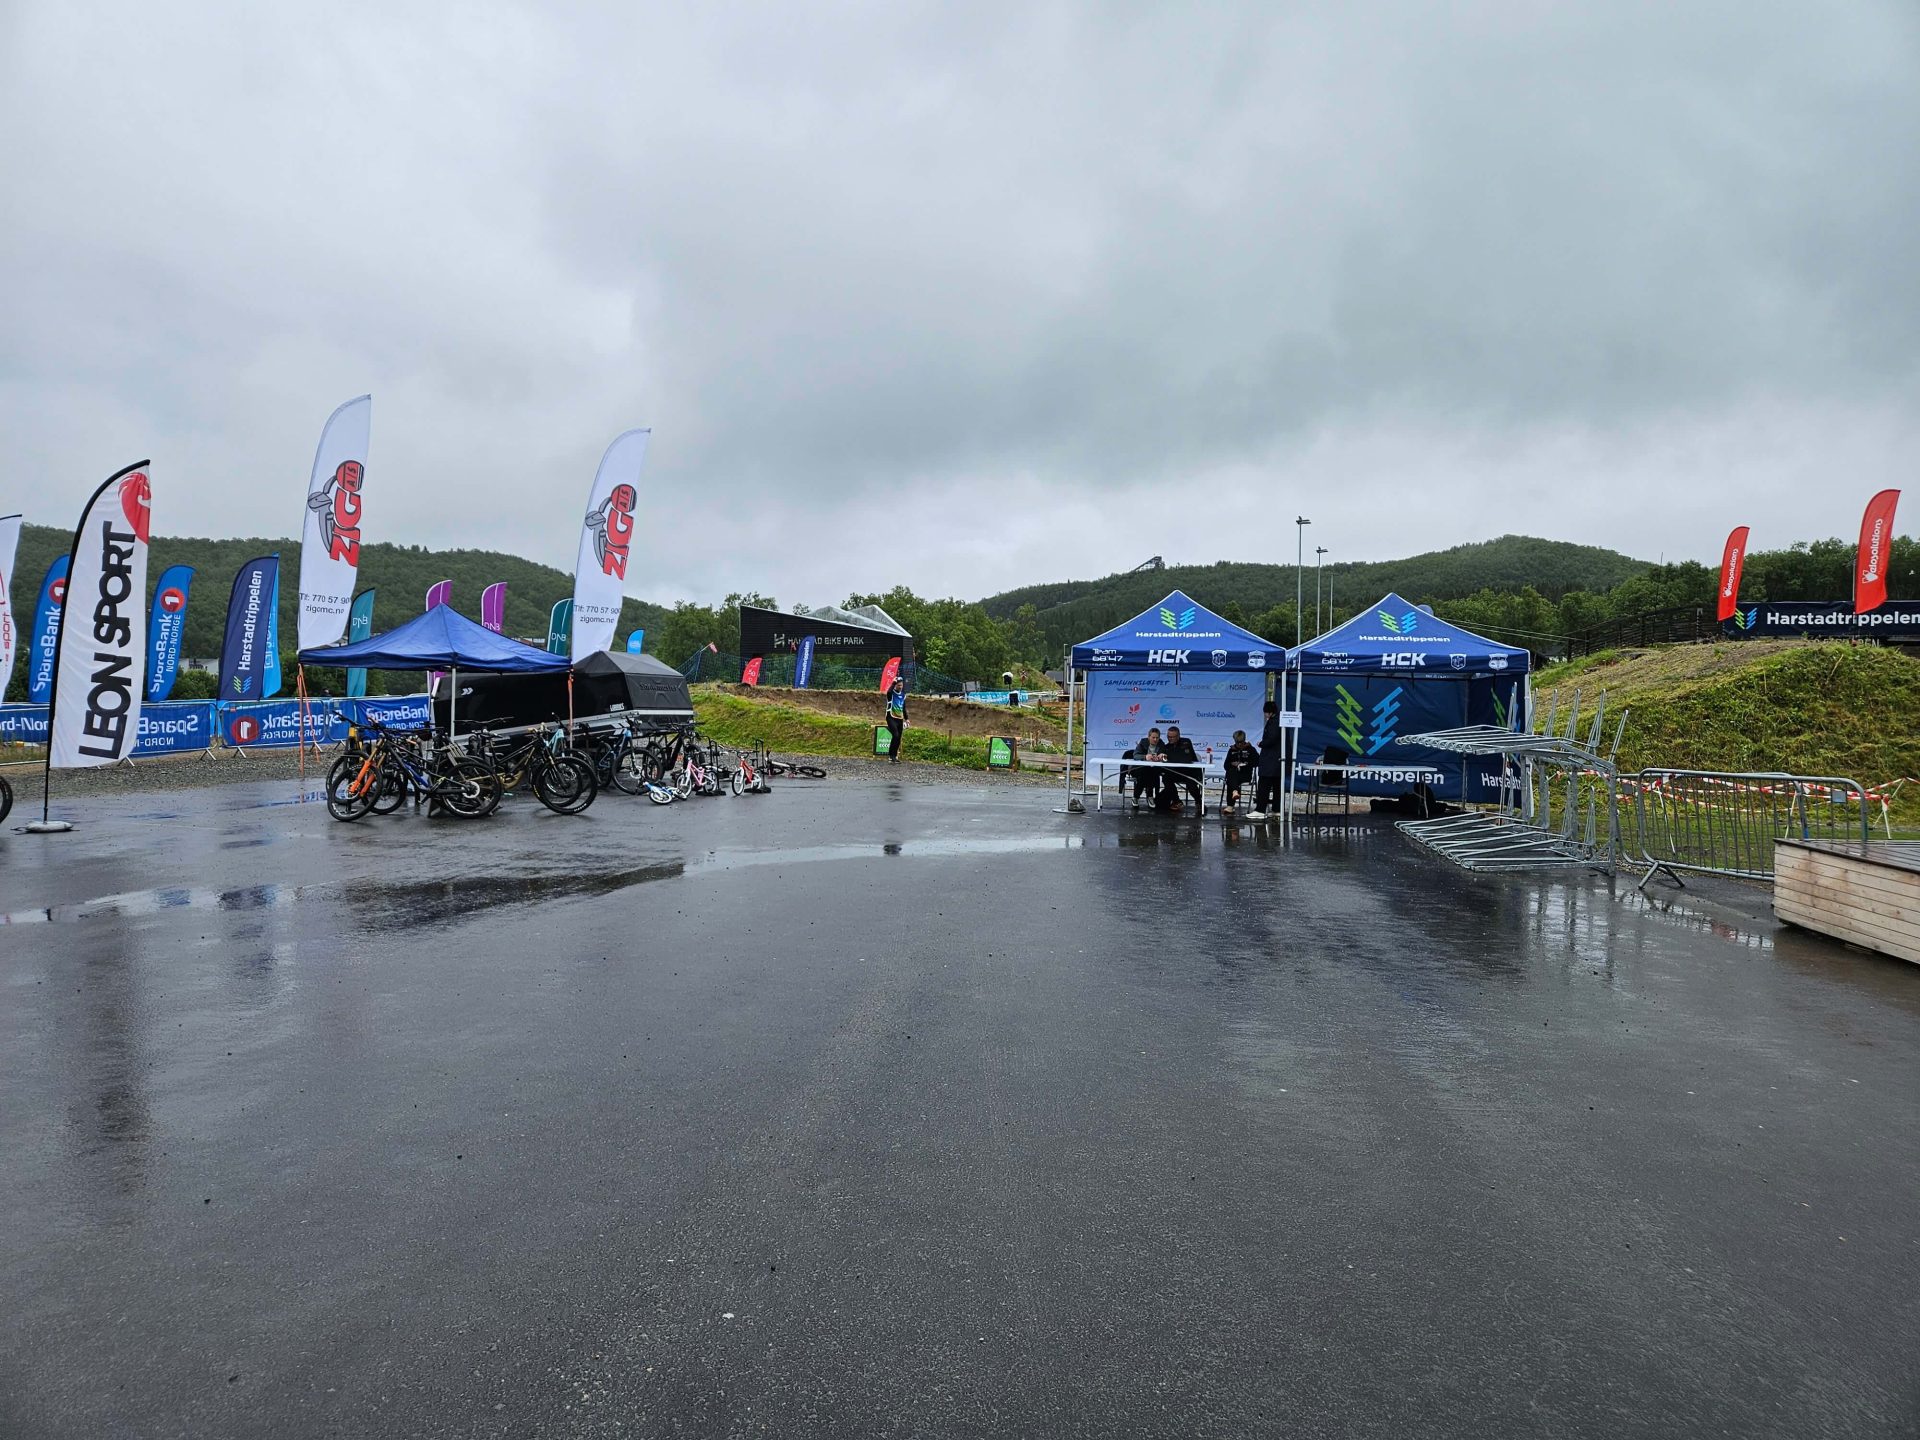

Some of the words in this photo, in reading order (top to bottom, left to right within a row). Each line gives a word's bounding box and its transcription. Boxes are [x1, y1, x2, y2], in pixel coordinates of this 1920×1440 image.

[93, 520, 136, 648] SPORT
[312, 593, 326, 603] 770
[327, 595, 339, 604] 57
[305, 604, 345, 615] zigomc.no
[586, 605, 599, 613] 770
[237, 570, 263, 671] Harstadtrippelen
[1766, 611, 1920, 627] Harstadtrippelen
[166, 614, 182, 673] NORD-NORGE
[550, 632, 567, 642] DNB
[824, 637, 842, 645] BIKE
[843, 636, 865, 645] PARK
[32, 606, 62, 692] SpareBank
[150, 613, 173, 693] SpareBank
[1147, 649, 1192, 664] HCK
[1381, 652, 1427, 666] HCK
[78, 652, 132, 760] LEON
